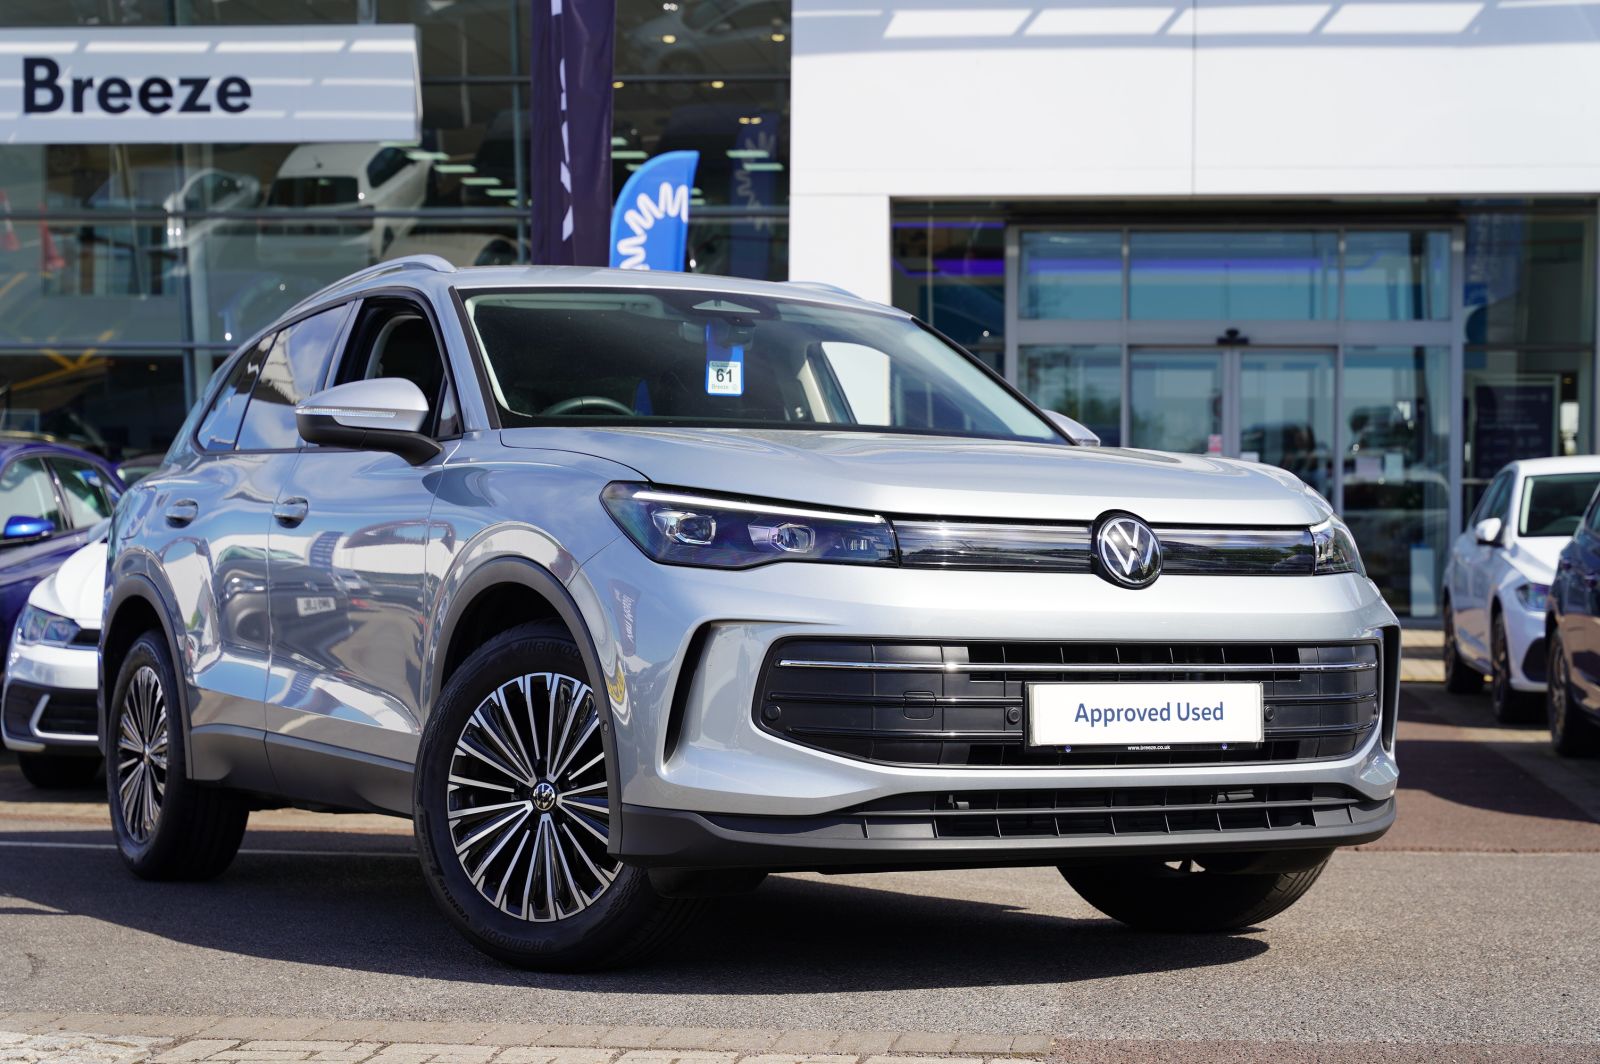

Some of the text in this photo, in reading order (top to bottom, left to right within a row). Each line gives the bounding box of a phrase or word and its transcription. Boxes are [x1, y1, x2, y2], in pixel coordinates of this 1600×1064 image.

[23, 56, 252, 116] Breeze
[716, 368, 732, 383] 61
[1074, 701, 1224, 728] Approved Used
